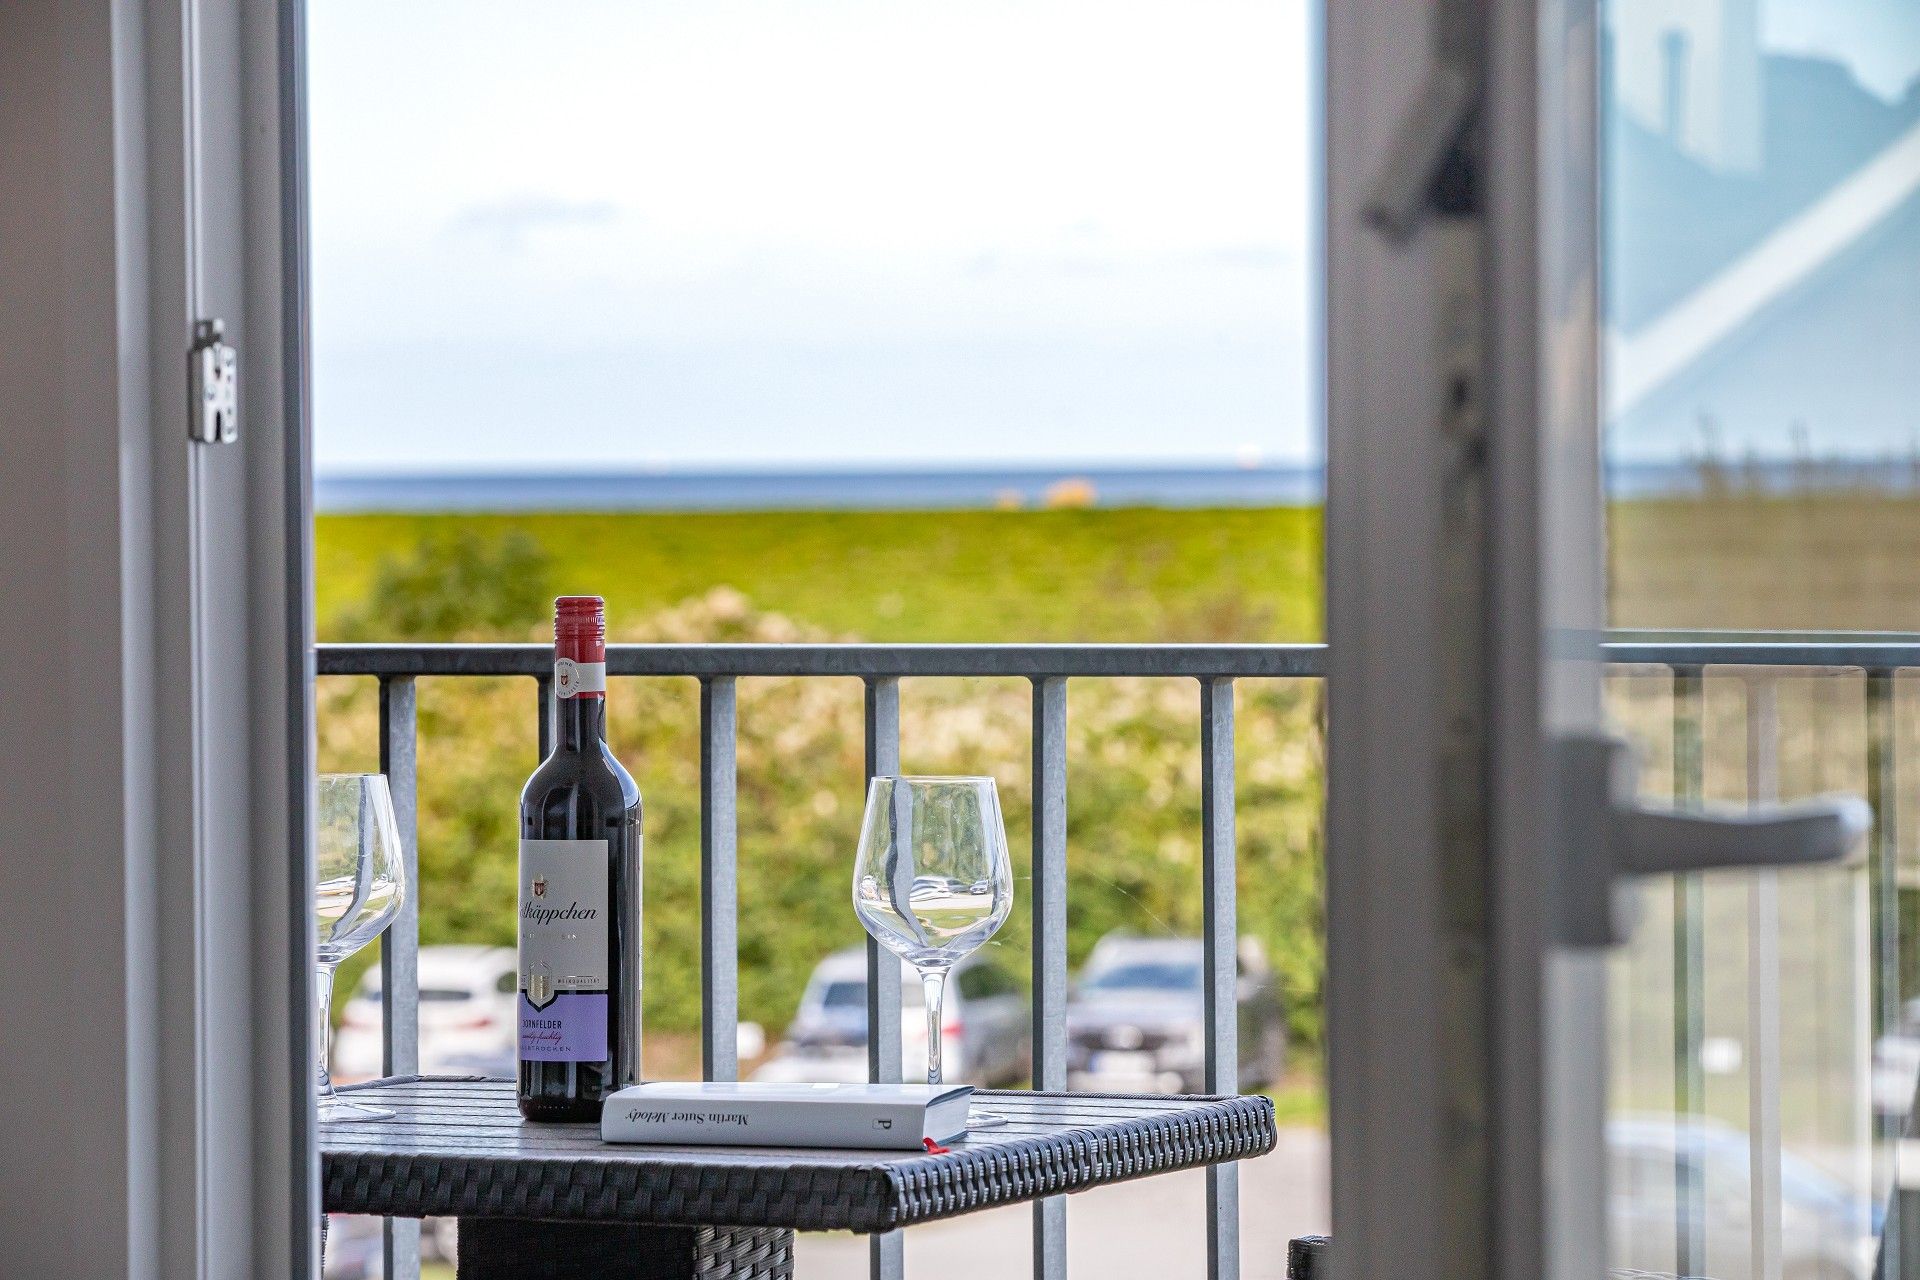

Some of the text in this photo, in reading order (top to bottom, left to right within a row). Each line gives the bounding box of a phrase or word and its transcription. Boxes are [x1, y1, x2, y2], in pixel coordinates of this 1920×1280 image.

[522, 901, 599, 926] tkäppchen
[625, 1108, 749, 1126] Martin Suter Melody
